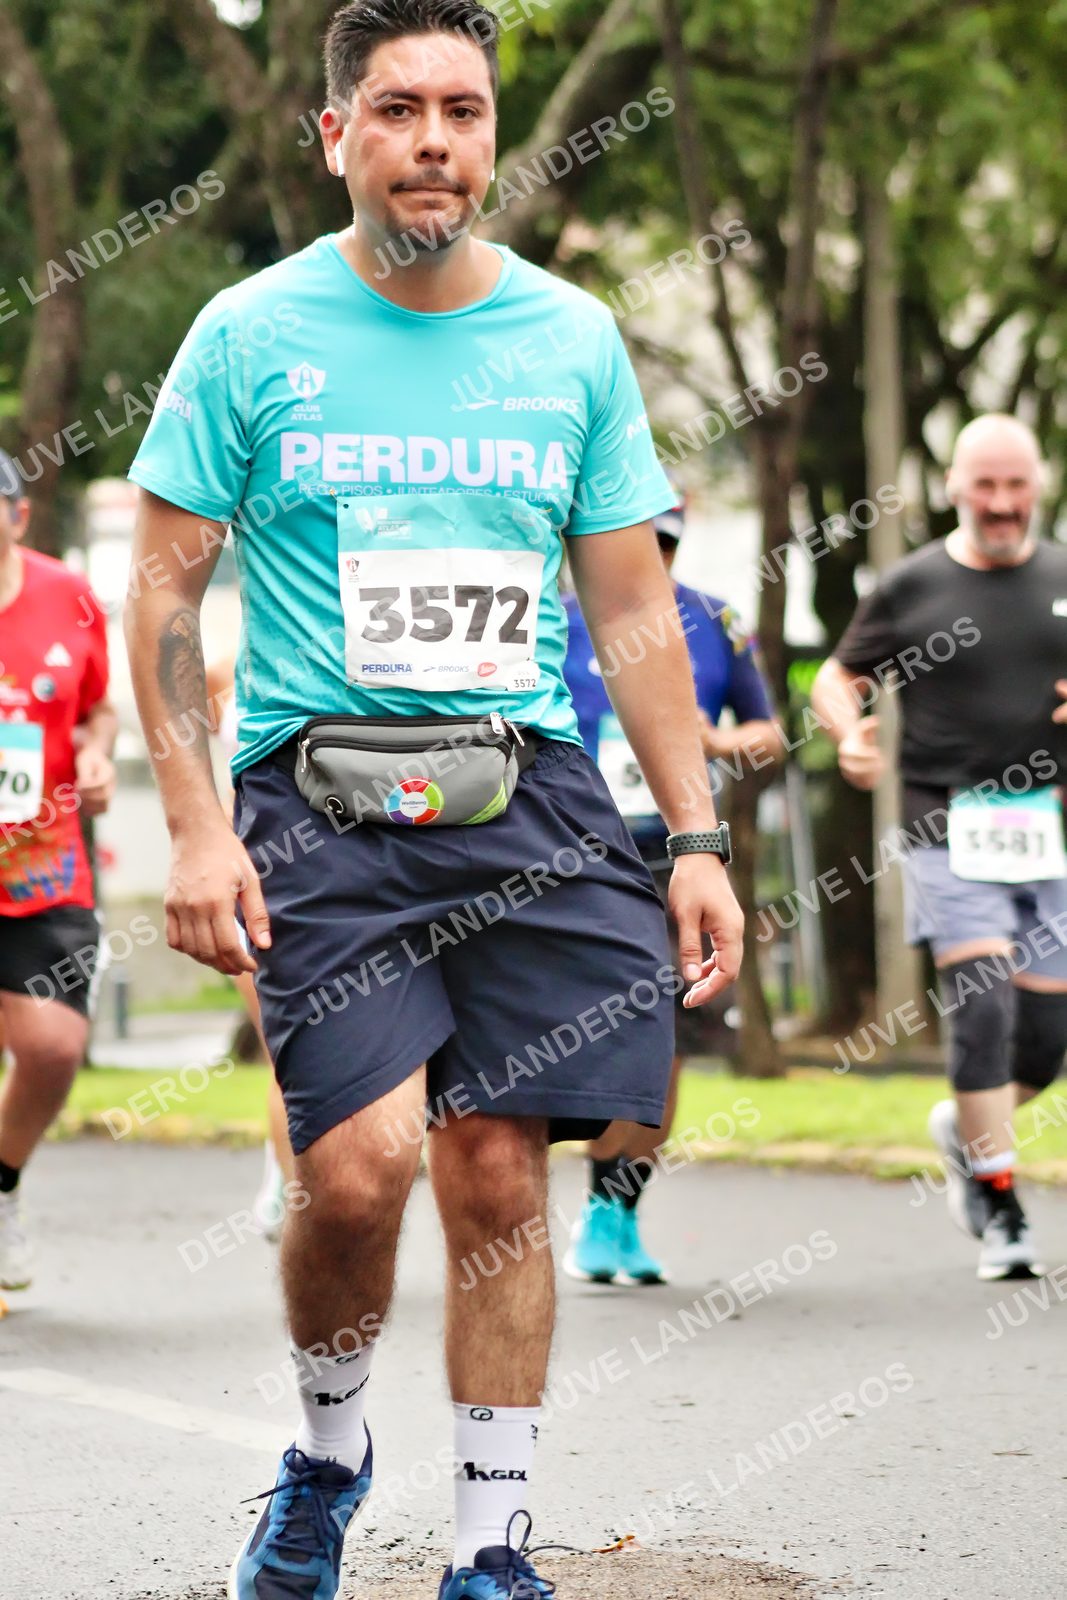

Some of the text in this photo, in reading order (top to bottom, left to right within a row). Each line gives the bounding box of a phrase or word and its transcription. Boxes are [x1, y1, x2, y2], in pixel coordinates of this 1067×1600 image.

[502, 397, 579, 412] BROOKS
[290, 413, 323, 421] ATLAS
[280, 432, 568, 489] PERDURA
[341, 485, 383, 496] PISOS
[359, 585, 529, 644] 3572
[362, 664, 412, 673] PERDURA
[514, 679, 536, 688] 3572
